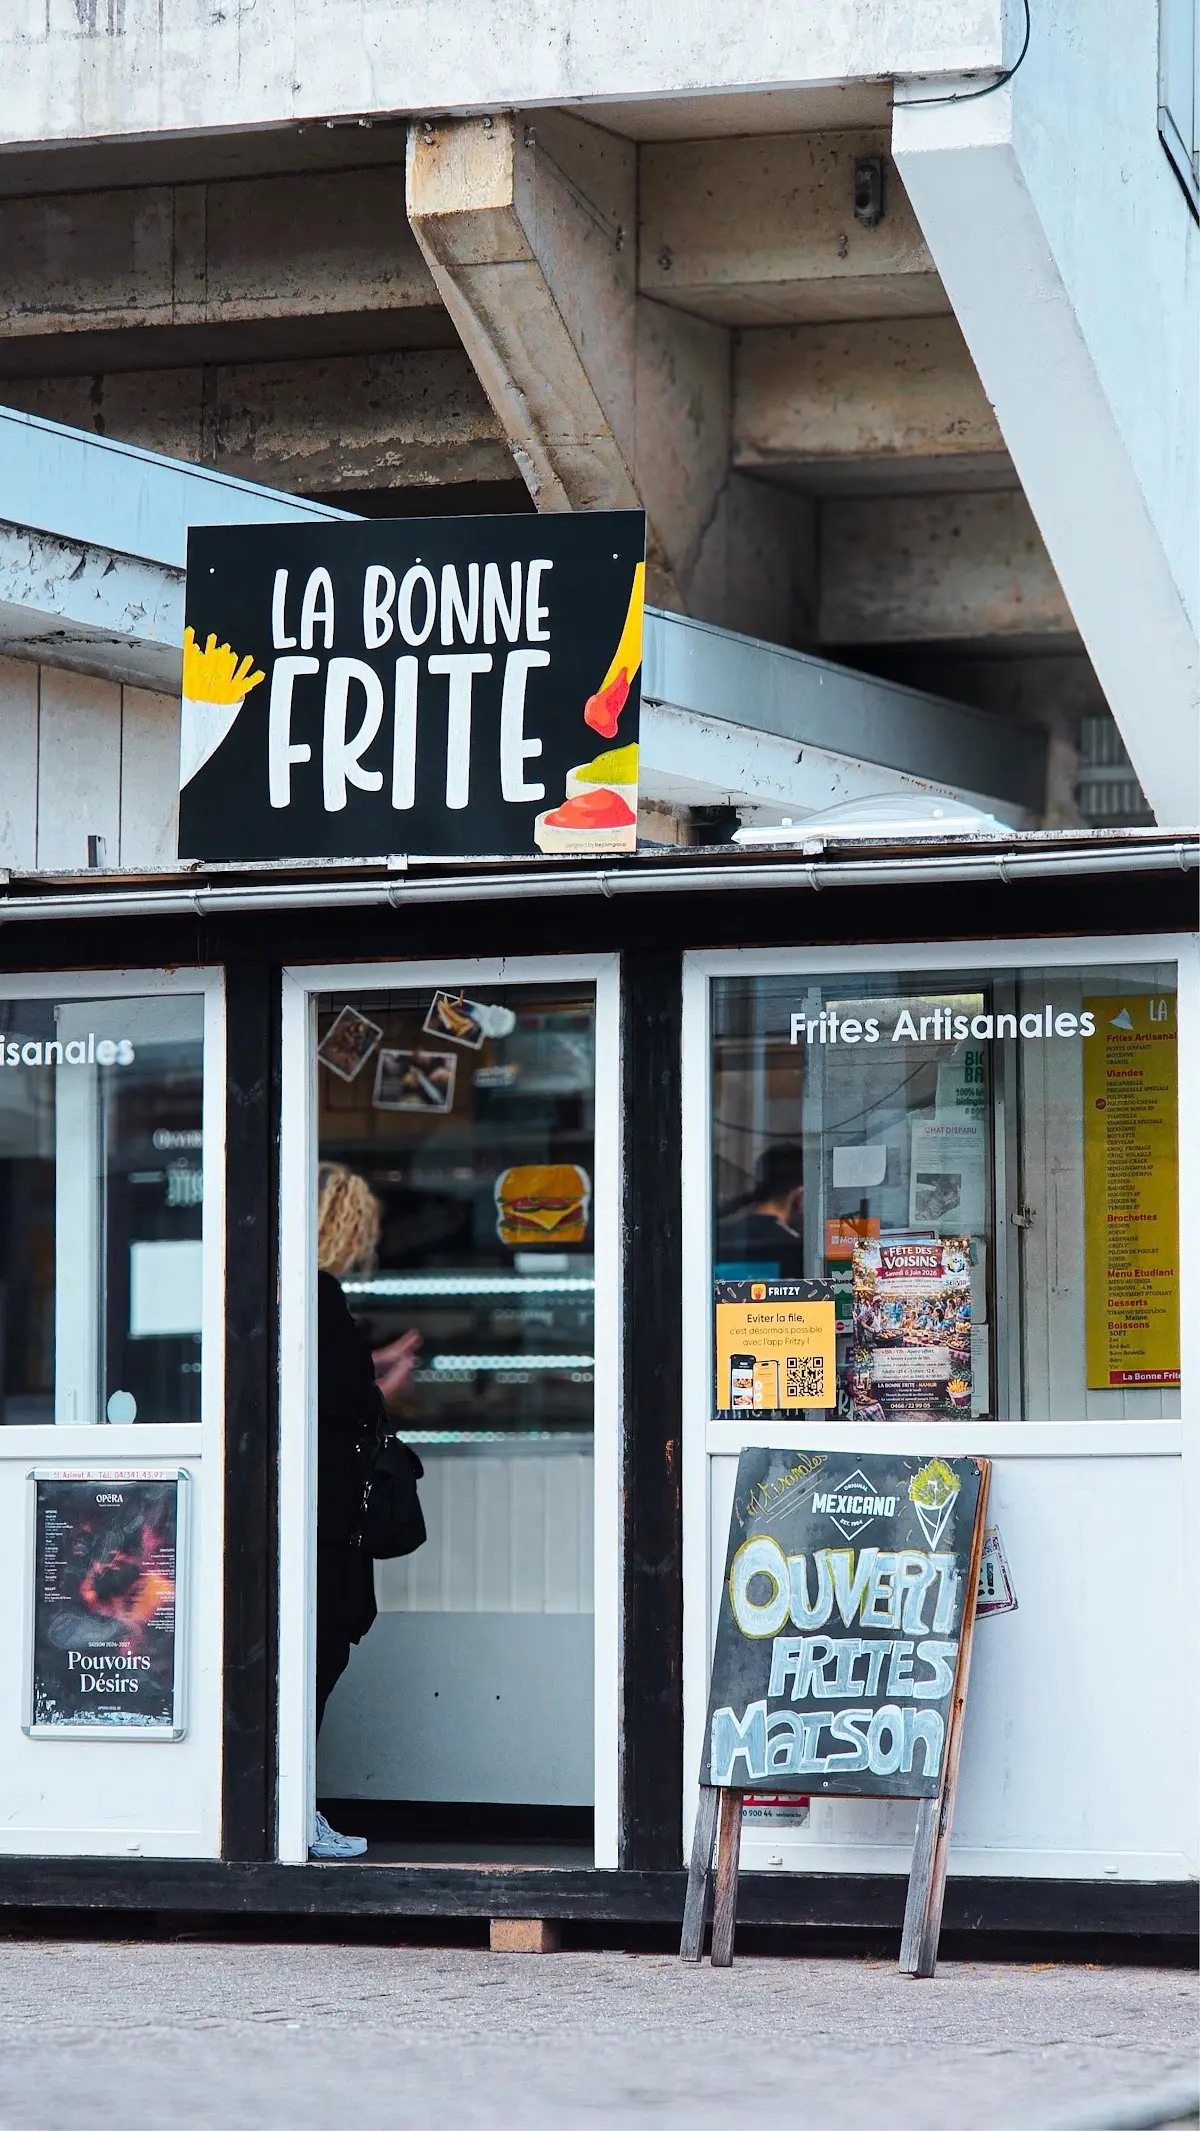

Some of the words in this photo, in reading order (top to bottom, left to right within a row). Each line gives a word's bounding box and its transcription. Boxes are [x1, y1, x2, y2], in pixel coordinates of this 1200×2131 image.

[272, 566, 334, 650] LA
[363, 559, 554, 650] BONNE
[268, 648, 551, 812] FRITE
[1149, 999, 1168, 1021] LA
[789, 1011, 879, 1045] Frites
[892, 1004, 1095, 1042] Artisanales
[1106, 1034, 1133, 1043] Frites
[1107, 1069, 1144, 1078] Viandes
[1107, 1214, 1157, 1222] Brochettes
[889, 1246, 912, 1257] FÊTE
[916, 1247, 932, 1255] DES
[884, 1256, 938, 1270] VOISINS
[885, 1269, 904, 1277] Samedi
[1107, 1270, 1132, 1278] Menu
[1135, 1269, 1173, 1278] Etudiant
[768, 1286, 800, 1296] FRITZY
[1107, 1299, 1148, 1307] Desserts
[747, 1314, 774, 1323] Eviter
[776, 1313, 786, 1322] la
[788, 1313, 805, 1323] file,
[730, 1326, 747, 1335] c'est
[749, 1326, 789, 1335] désormais
[790, 1325, 823, 1335] possible
[1107, 1321, 1150, 1330] Boissons
[763, 1338, 783, 1347] l'app
[785, 1337, 805, 1347] Fritzy
[1122, 1373, 1132, 1381] La
[1135, 1372, 1161, 1380] Bonne
[843, 1483, 868, 1492] ORIGINAL
[811, 1492, 896, 1517] MEXICANO
[839, 1518, 850, 1527] EST.
[730, 1534, 958, 1639] OUVERT
[68, 1650, 151, 1670] Pouvoirs
[767, 1635, 958, 1700] FRITES
[80, 1672, 139, 1693] Désirs
[748, 1809, 763, 1817] 900
[764, 1809, 772, 1817] 44
